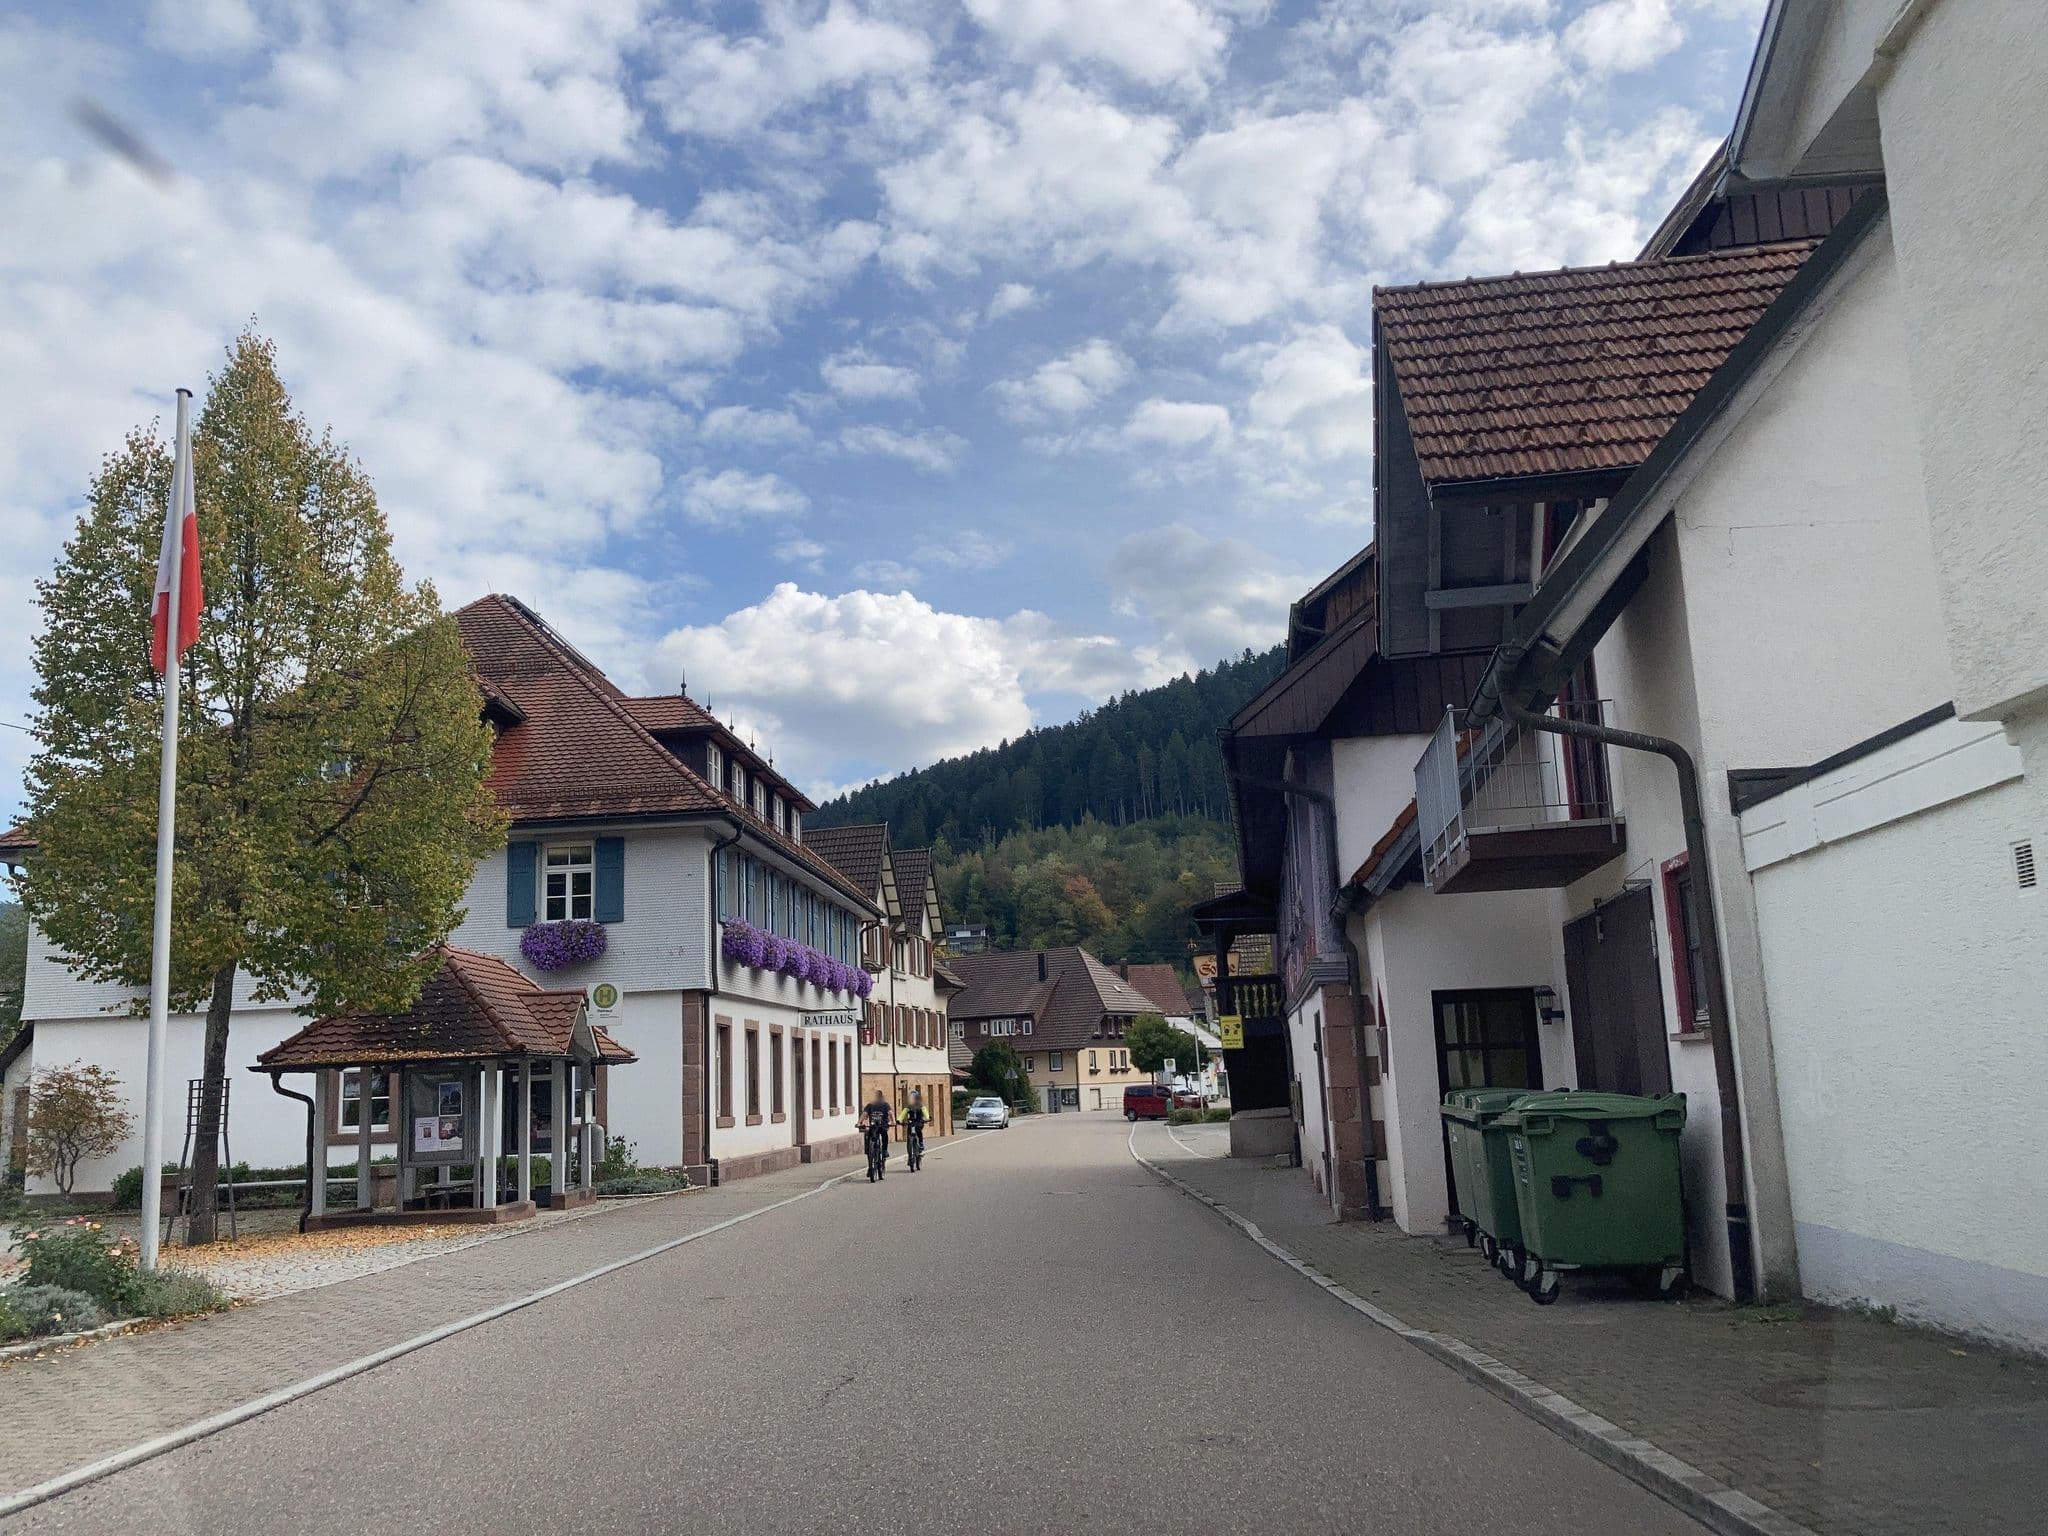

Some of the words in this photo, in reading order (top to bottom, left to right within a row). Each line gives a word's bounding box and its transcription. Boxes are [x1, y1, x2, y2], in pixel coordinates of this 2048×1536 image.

[1199, 961, 1237, 976] Soe
[599, 989, 612, 1003] H
[804, 1014, 854, 1025] RATHAUS
